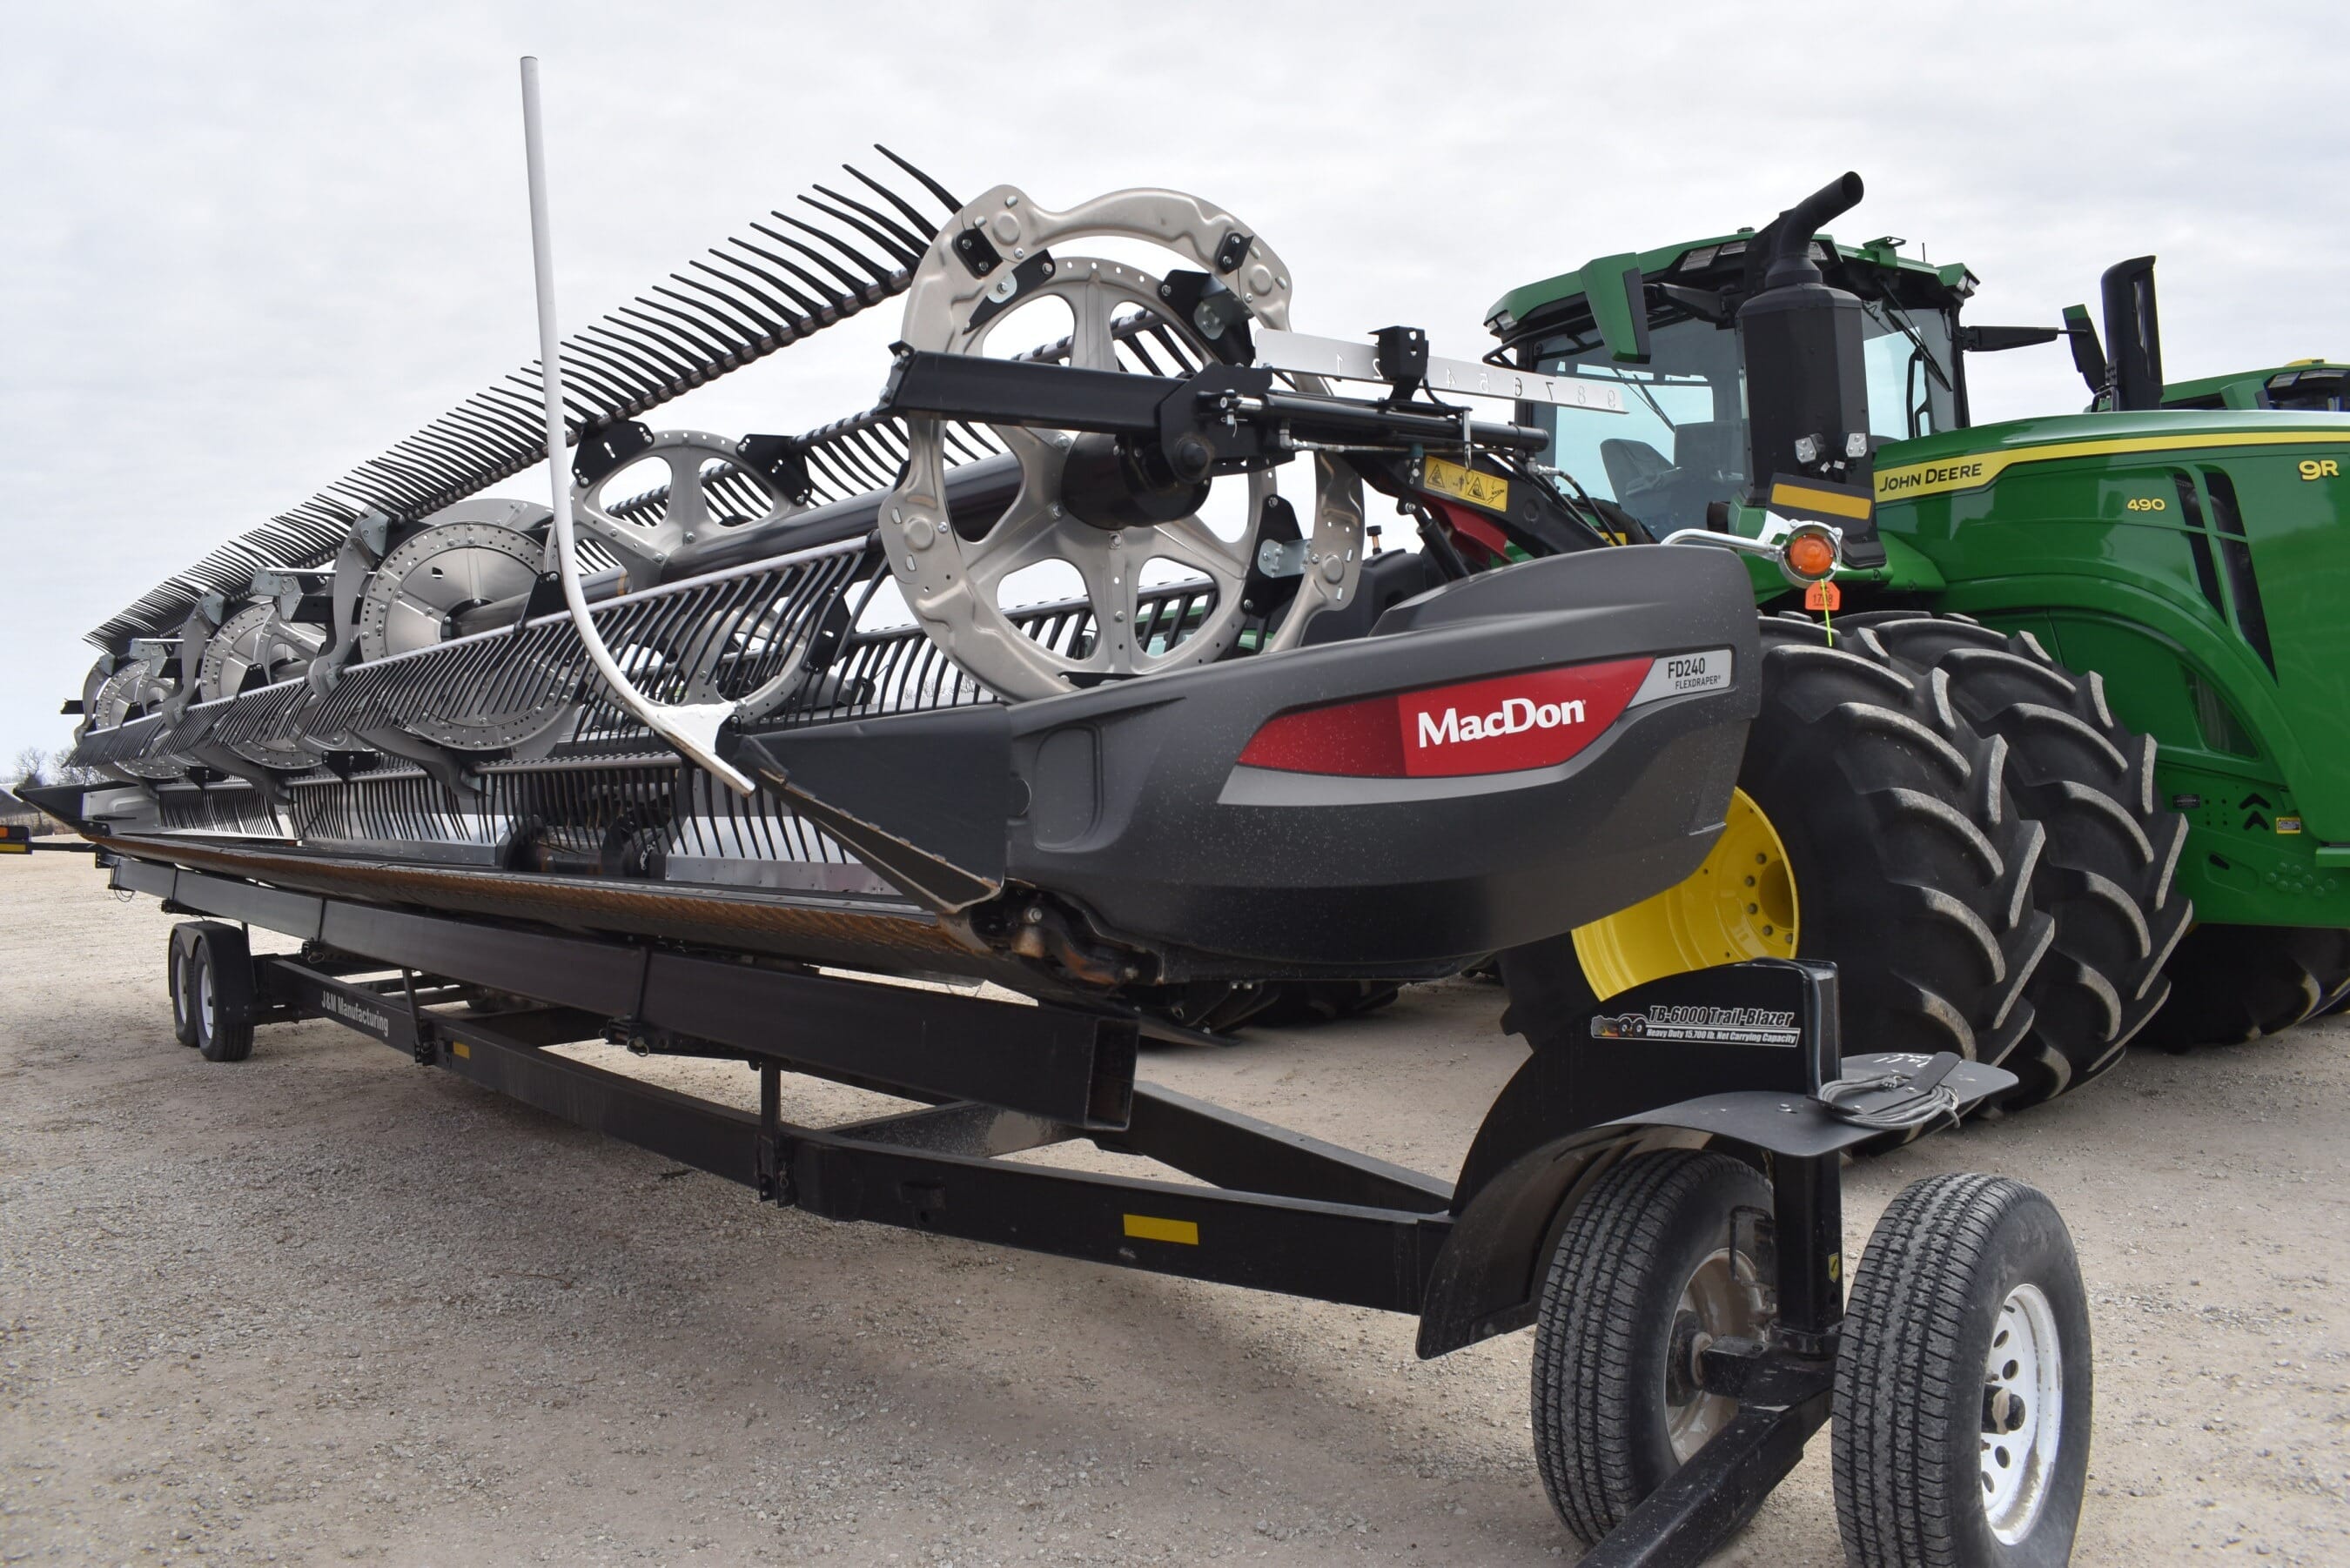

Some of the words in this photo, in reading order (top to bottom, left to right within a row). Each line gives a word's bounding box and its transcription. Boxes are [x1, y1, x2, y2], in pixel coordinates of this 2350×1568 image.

[2298, 459, 2340, 481] 9R
[2126, 498, 2166, 512] 490
[1813, 593, 1833, 604] 178
[1668, 657, 1706, 679] FD240
[1418, 698, 1585, 748] MacDon
[321, 990, 336, 1012] J&M
[338, 996, 388, 1037] Manufacturing
[1649, 1006, 1708, 1023] TB-6000
[1709, 1007, 1794, 1027] Trail-Blazer
[1647, 1029, 1668, 1038] Heavy
[1668, 1029, 1684, 1038] Duty
[1716, 1031, 1729, 1040] Net
[1729, 1032, 1762, 1042] Carrying
[1762, 1034, 1796, 1044] Capacity
